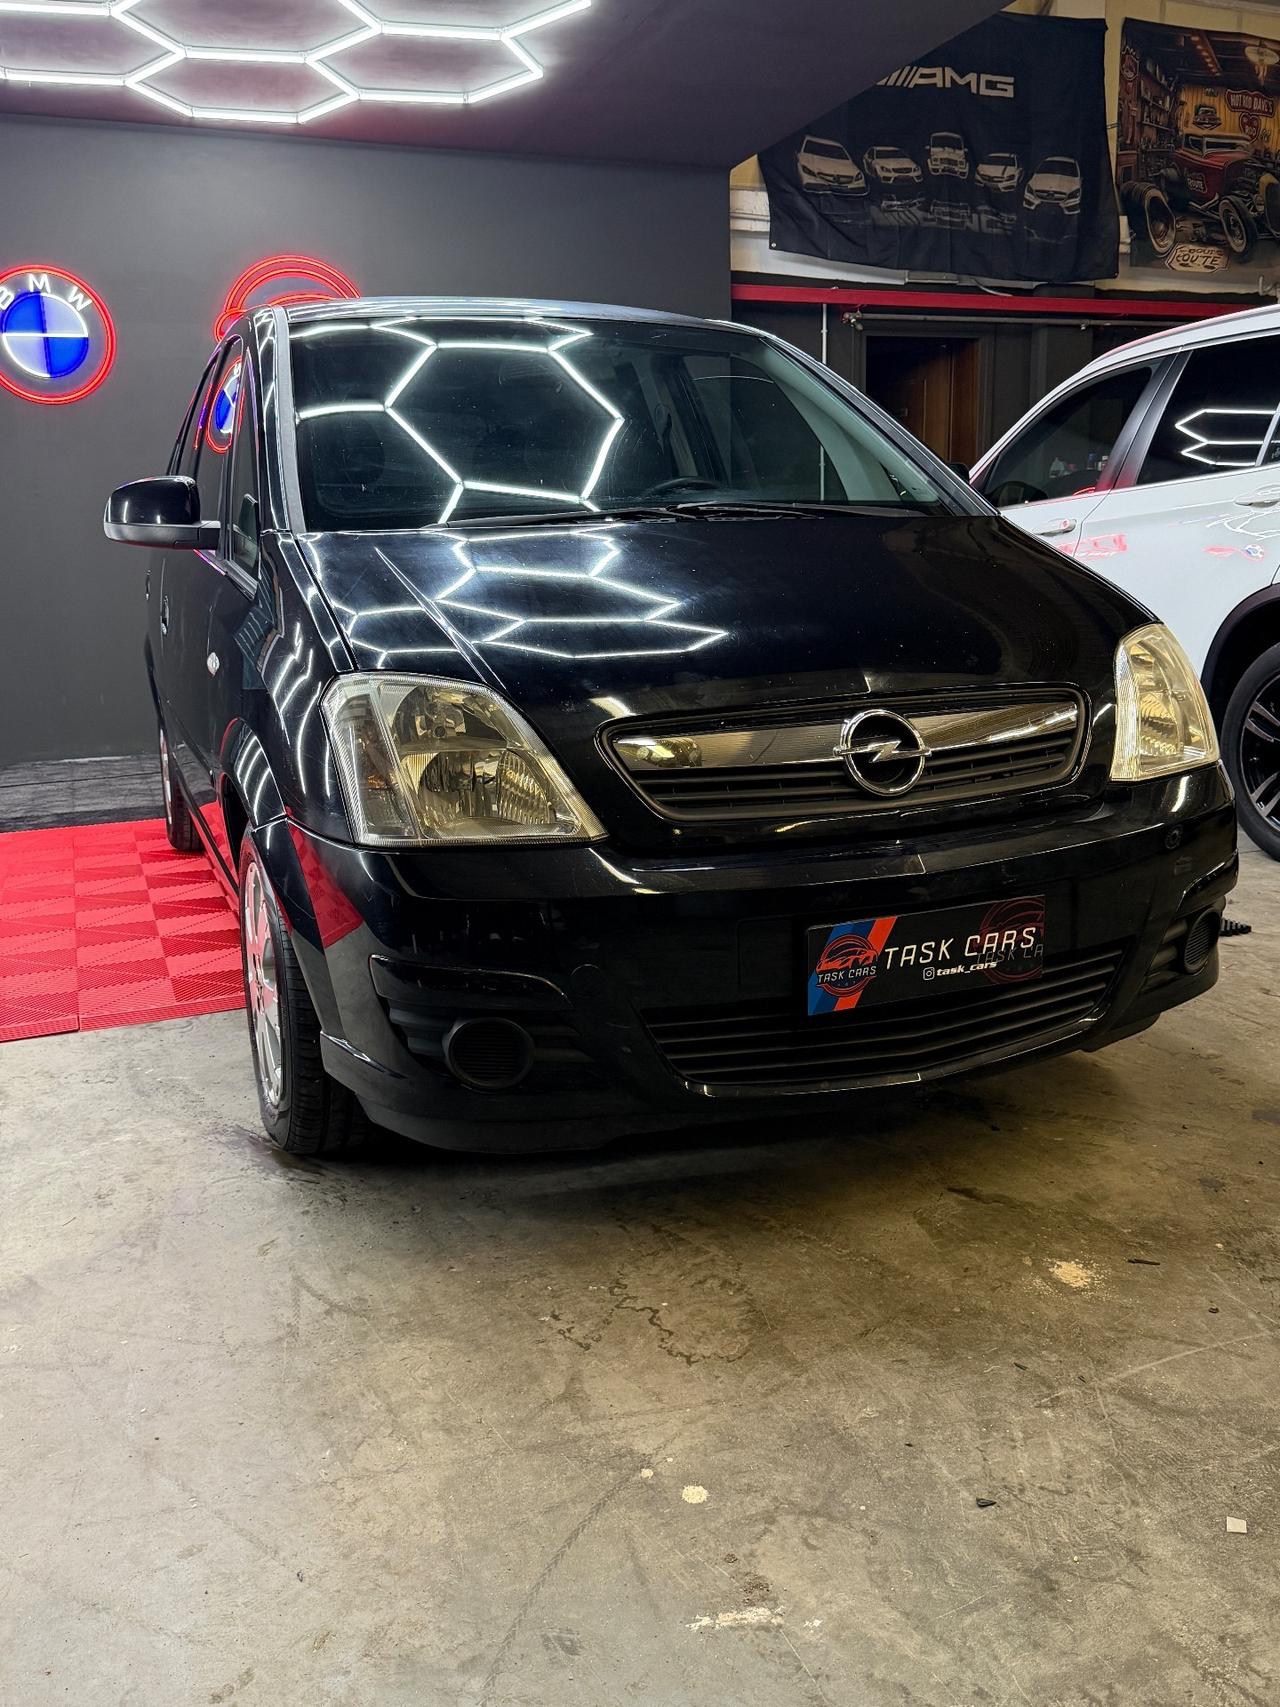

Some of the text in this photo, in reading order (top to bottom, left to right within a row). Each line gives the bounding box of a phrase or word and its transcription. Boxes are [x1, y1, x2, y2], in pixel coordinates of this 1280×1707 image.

[907, 66, 1014, 98] AMG
[1230, 94, 1242, 107] HOT
[0, 273, 93, 311] BMW
[884, 926, 1036, 970] TASK CARS
[818, 965, 877, 983] TASK CARS
[936, 960, 998, 977] task_cars
